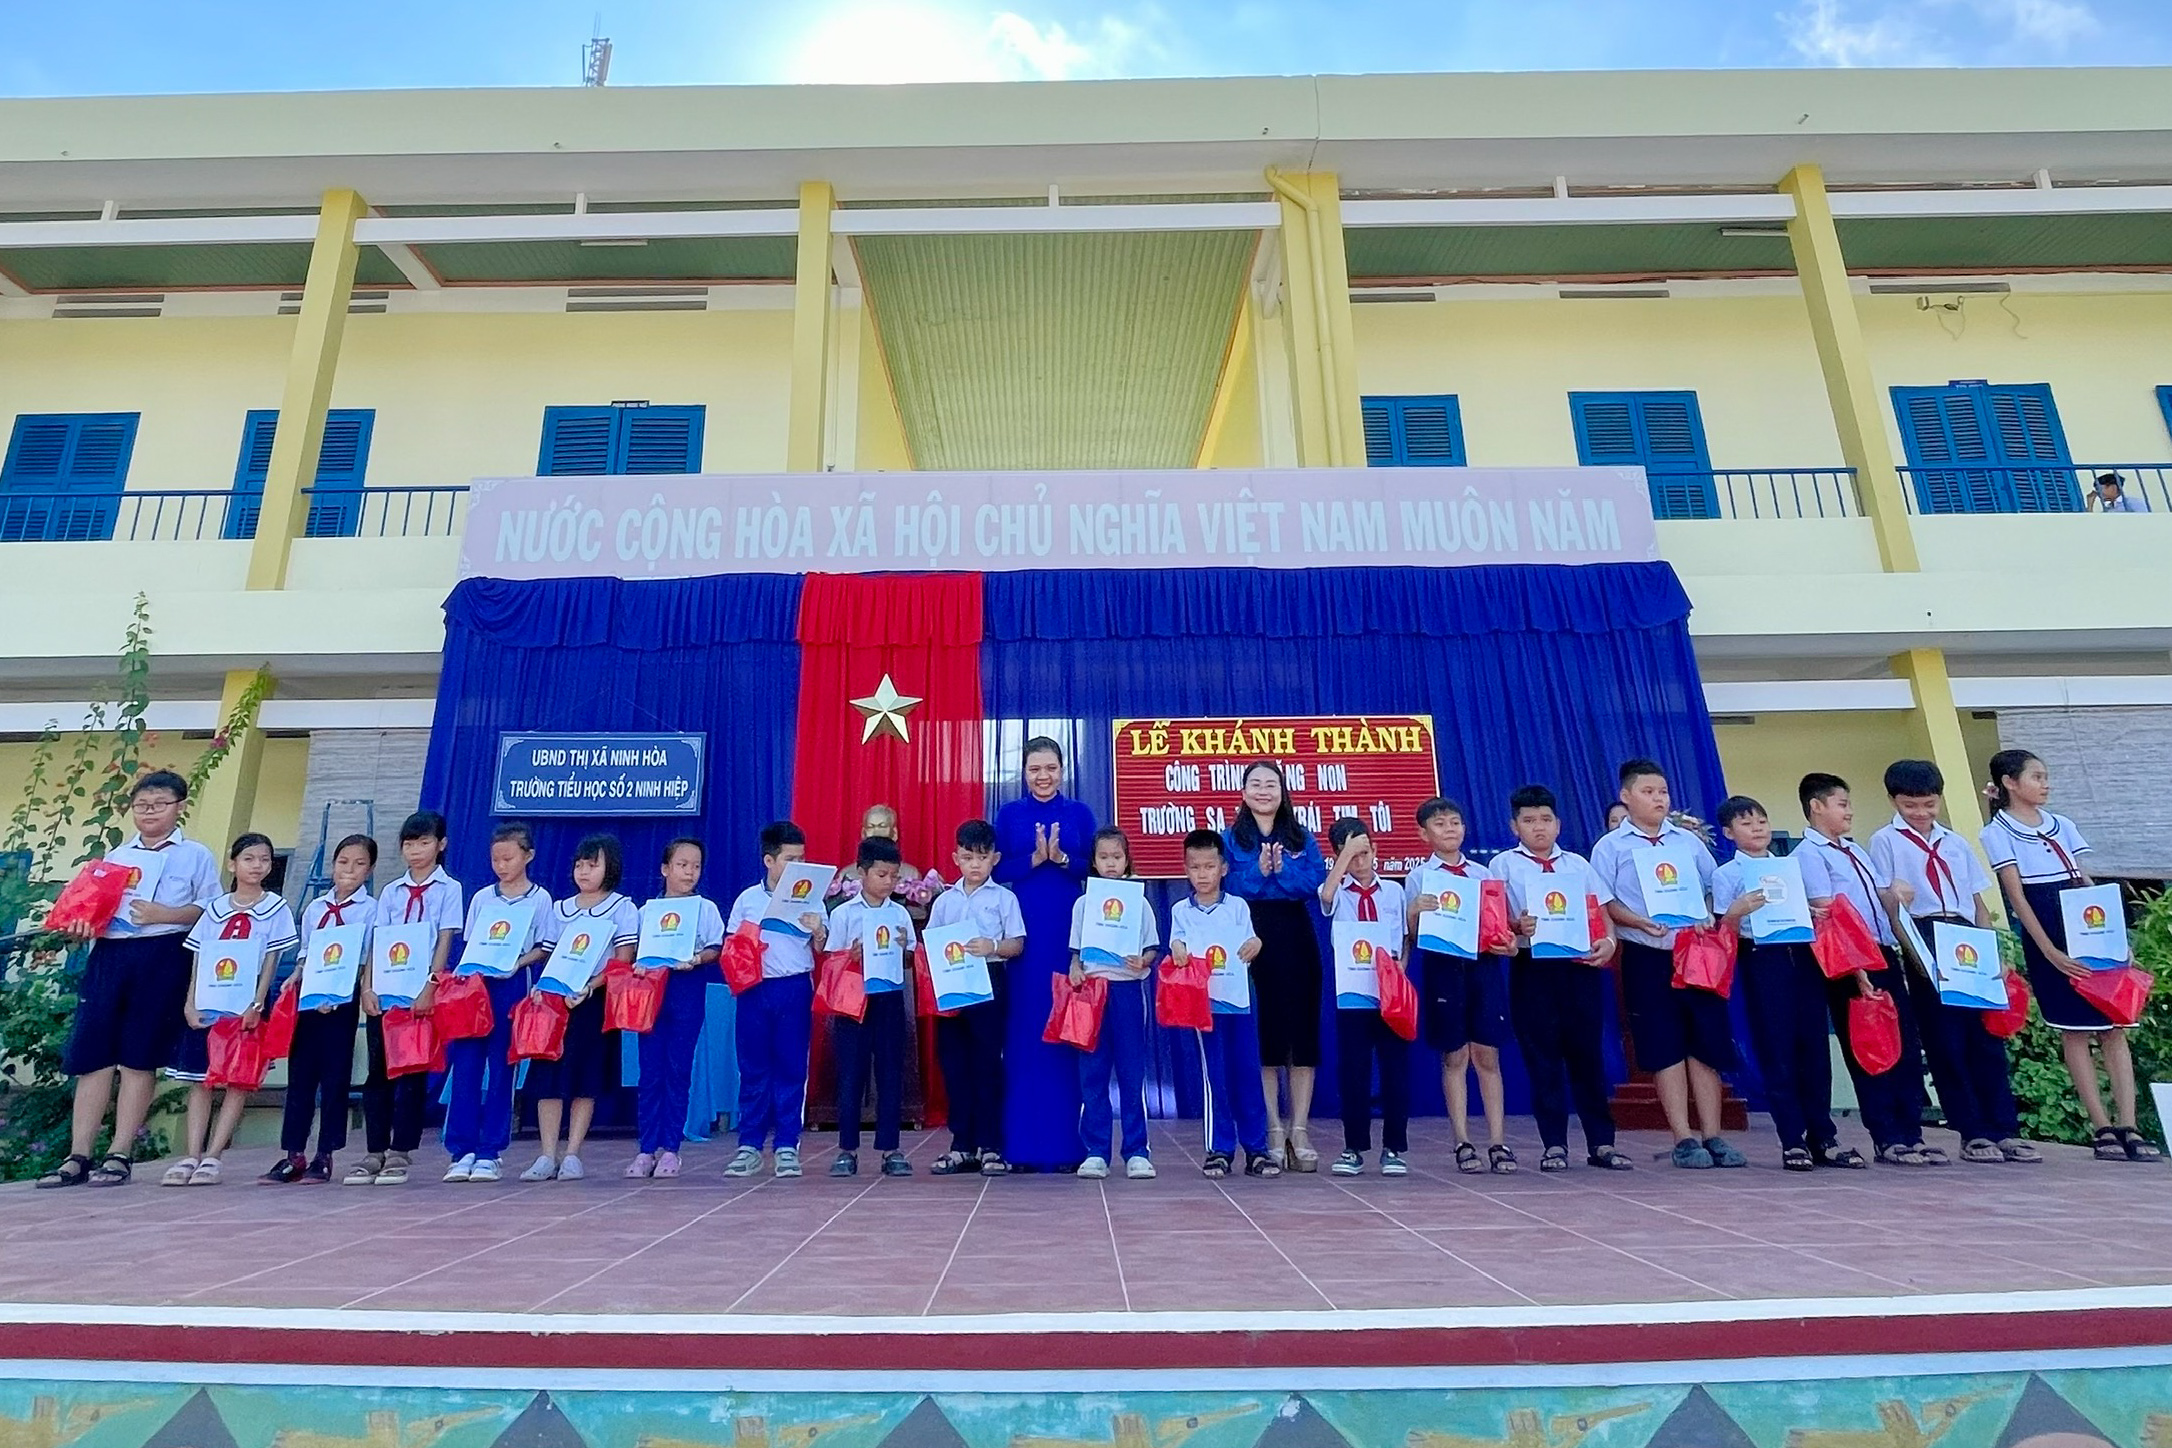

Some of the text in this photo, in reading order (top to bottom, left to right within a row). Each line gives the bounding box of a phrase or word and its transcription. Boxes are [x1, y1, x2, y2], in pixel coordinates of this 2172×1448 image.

[494, 482, 1623, 571] NƯỚC CỘNG HÒA XÃ HỘI CHỦ NGHĨA VIỆT NAM MUÔN NĂM
[1130, 717, 1423, 755] LỄ KHÁNH THÀNH
[531, 745, 668, 770] UBND THỊ XÃ NINH HÒA
[510, 771, 689, 801] TRƯỜNG TIỂU HỌC SỐ 2 NINH HIỆP
[1165, 759, 1200, 792] CÔNG
[1317, 763, 1348, 791] NON
[1140, 802, 1196, 835] TRƯỜNG
[1205, 806, 1225, 834] SA
[1370, 800, 1392, 832] TÔI
[1383, 856, 1403, 871] năm
